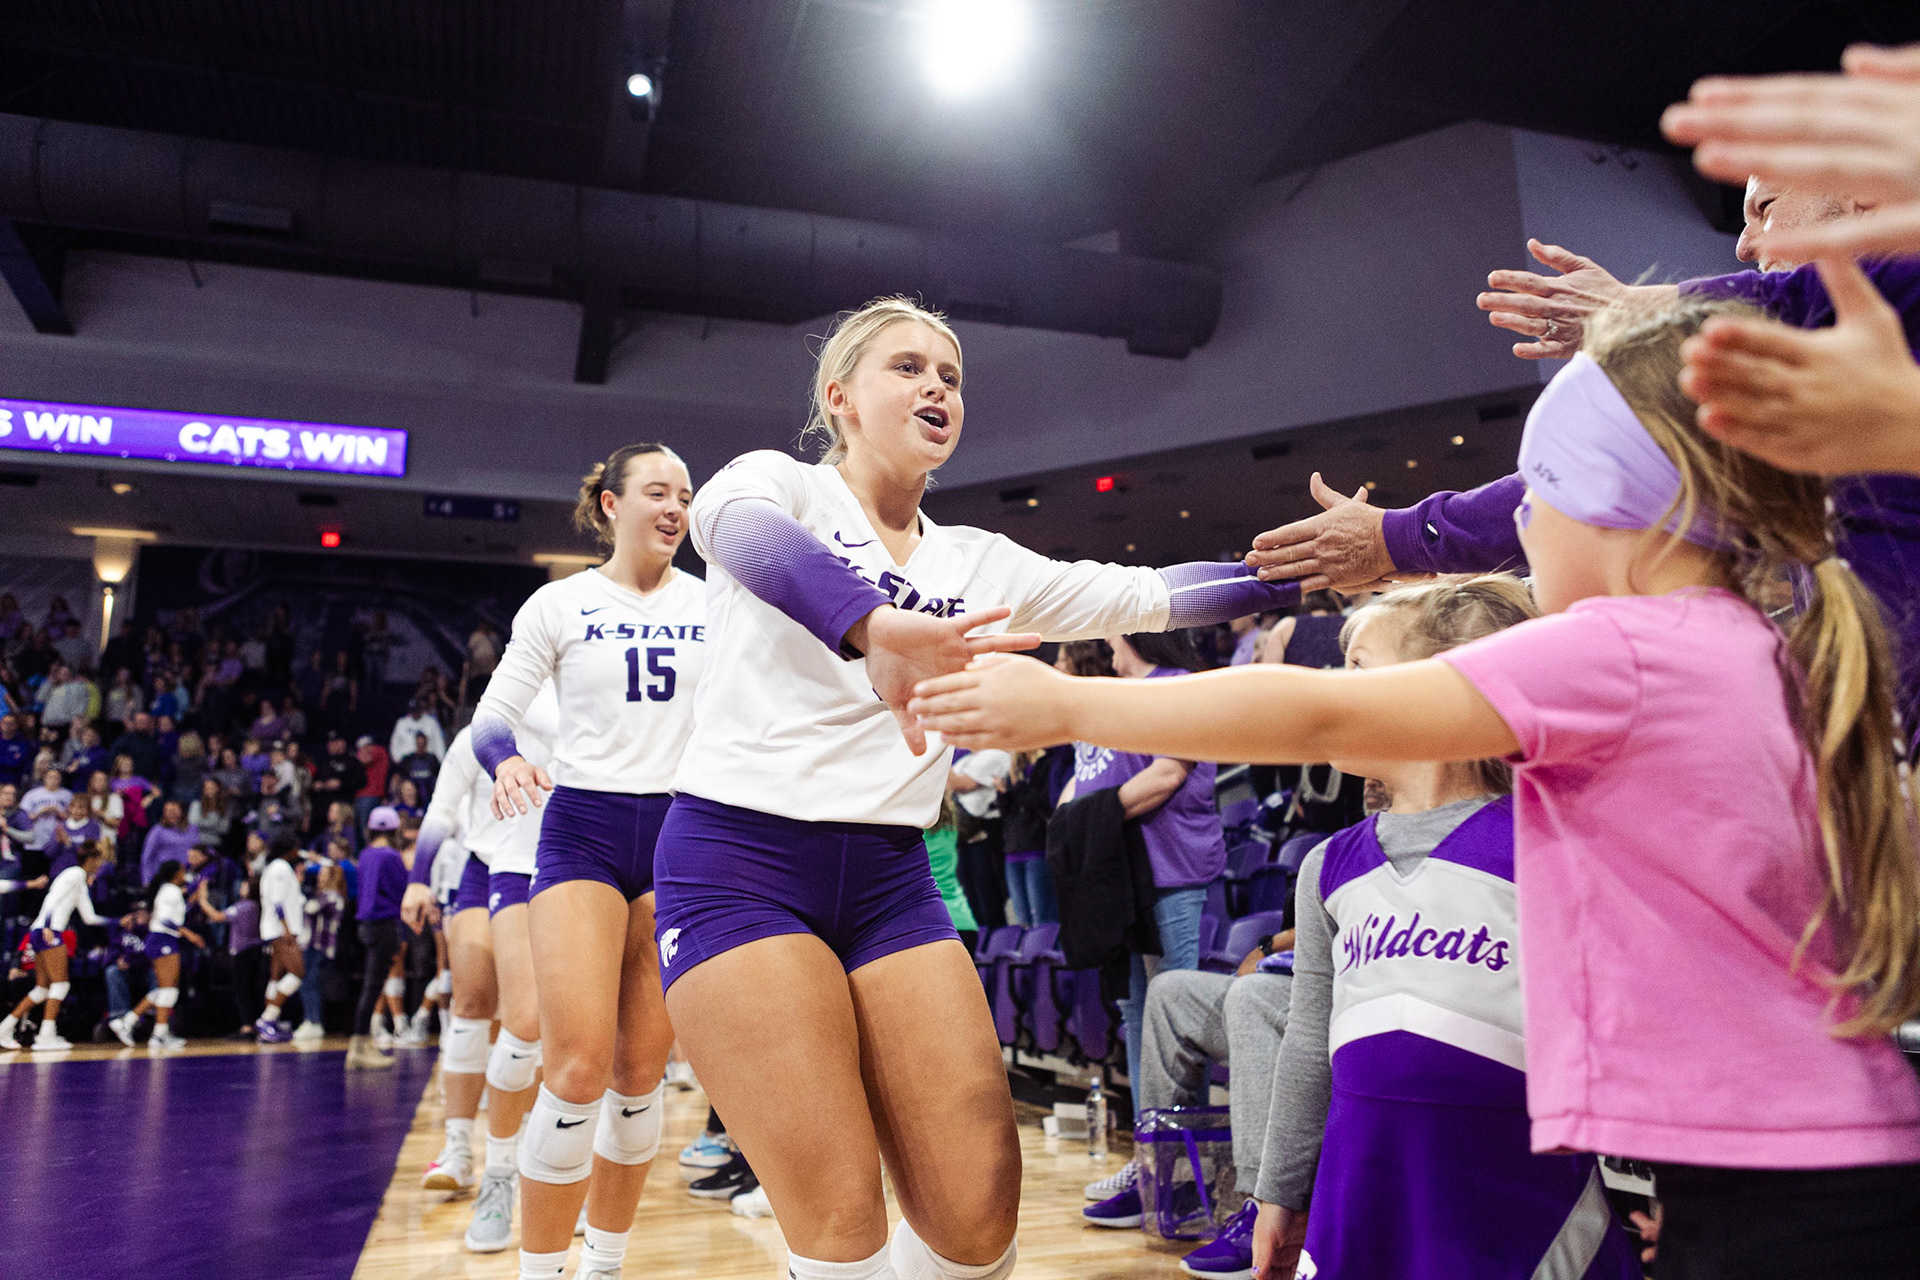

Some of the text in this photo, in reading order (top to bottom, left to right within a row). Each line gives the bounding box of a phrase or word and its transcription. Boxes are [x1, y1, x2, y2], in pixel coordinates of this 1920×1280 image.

[22, 410, 113, 446] WIN
[178, 421, 388, 467] CATS WIN
[584, 623, 706, 642] K-STATE
[625, 647, 677, 702] 15
[1339, 911, 1510, 976] Wildcats
